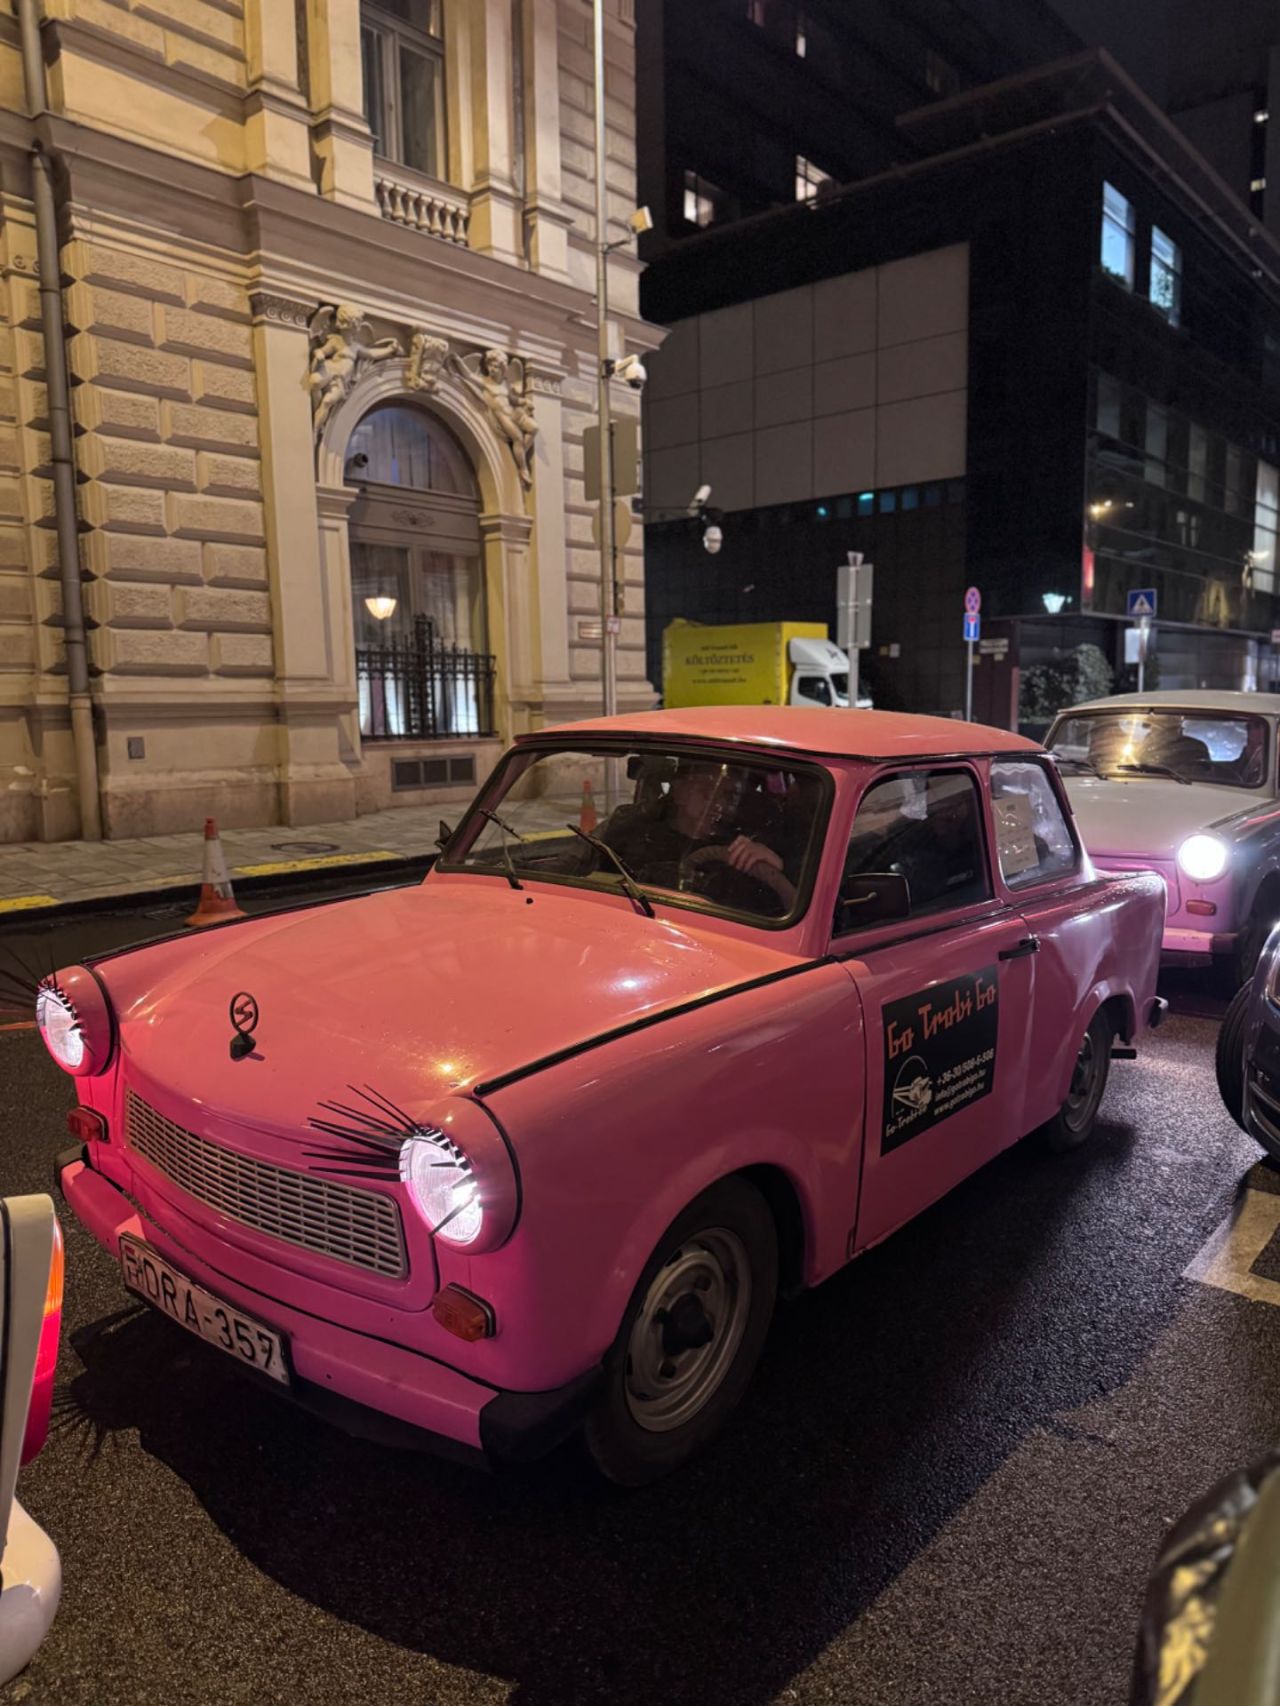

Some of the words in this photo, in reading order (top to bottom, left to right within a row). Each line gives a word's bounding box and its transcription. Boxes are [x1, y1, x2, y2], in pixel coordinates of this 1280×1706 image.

[887, 1020, 914, 1060] Go
[975, 977, 996, 1011] Go
[143, 1257, 275, 1369] DRA-357
